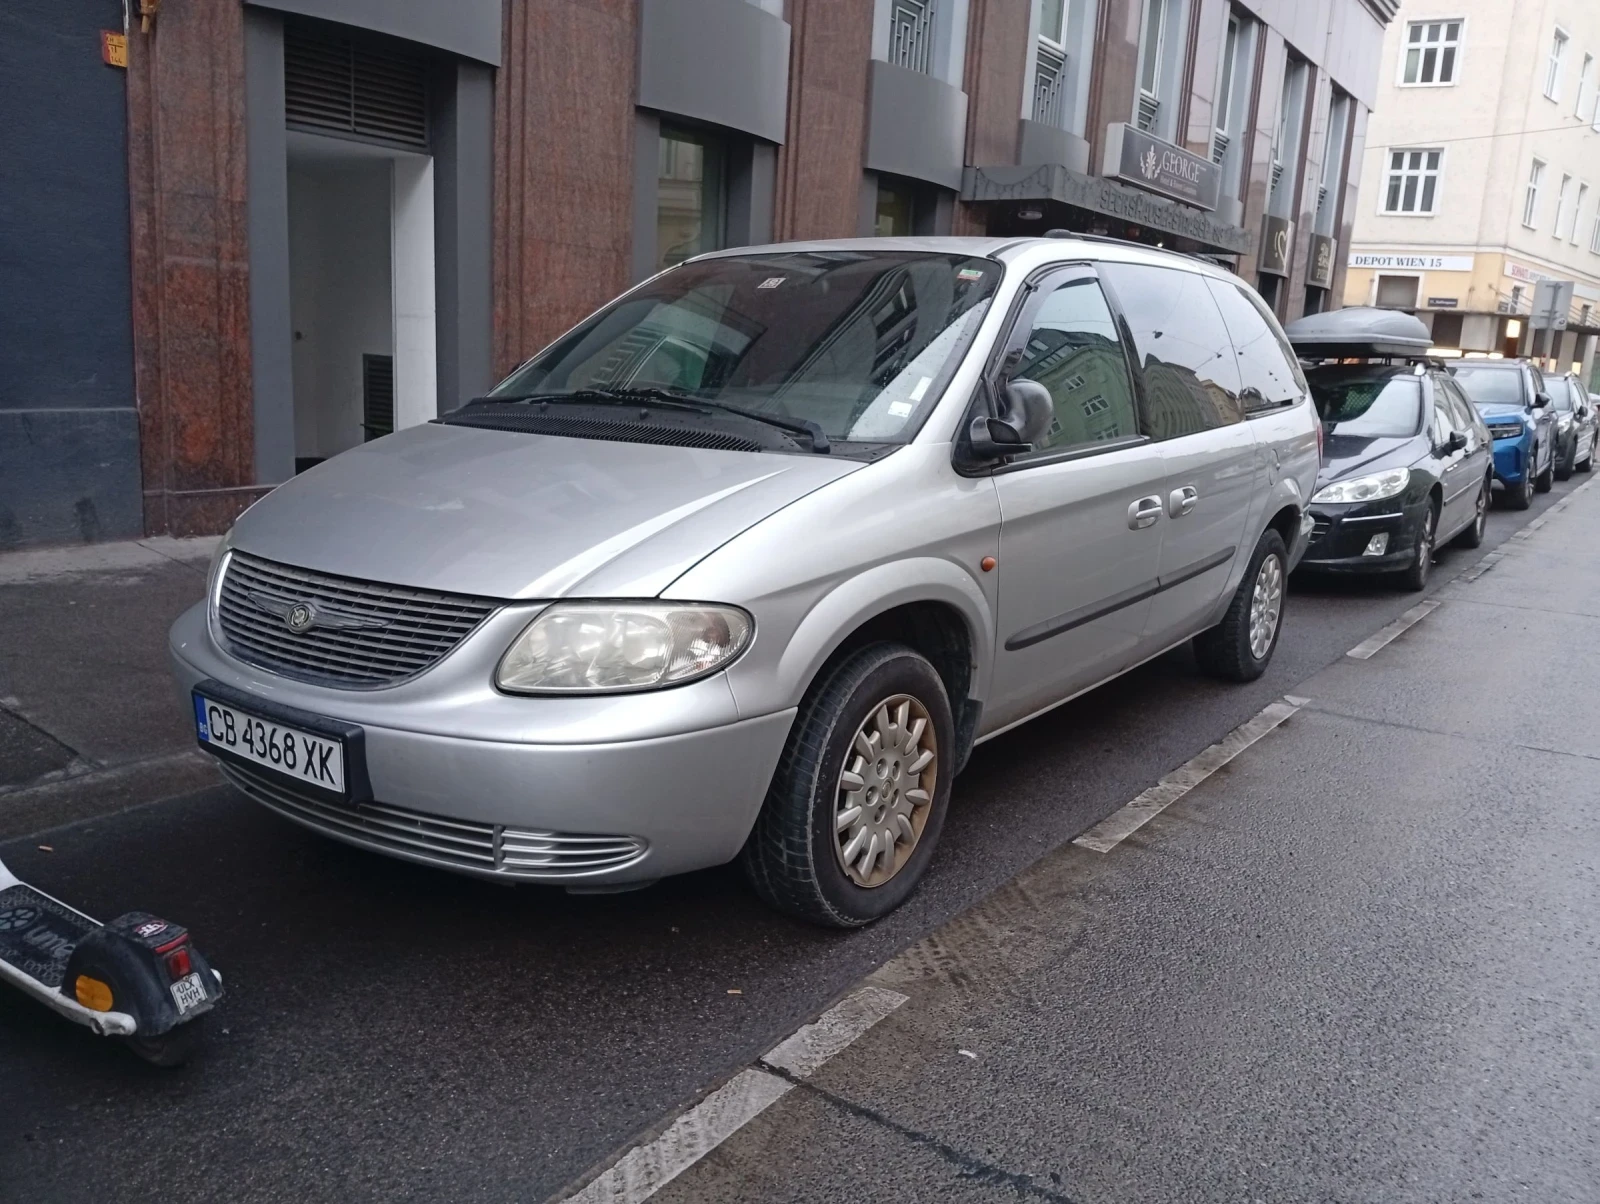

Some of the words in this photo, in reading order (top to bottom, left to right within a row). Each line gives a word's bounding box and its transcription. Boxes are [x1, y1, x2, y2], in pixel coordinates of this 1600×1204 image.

[1162, 150, 1200, 183] GEORGE
[1355, 256, 1393, 266] DEPOT
[1396, 257, 1426, 267] WIEN
[1429, 258, 1442, 267] 15
[208, 705, 237, 747] CB
[242, 718, 298, 770] 4368
[303, 736, 337, 786] XK
[177, 979, 196, 994] ULX
[180, 988, 201, 1004] HVH
